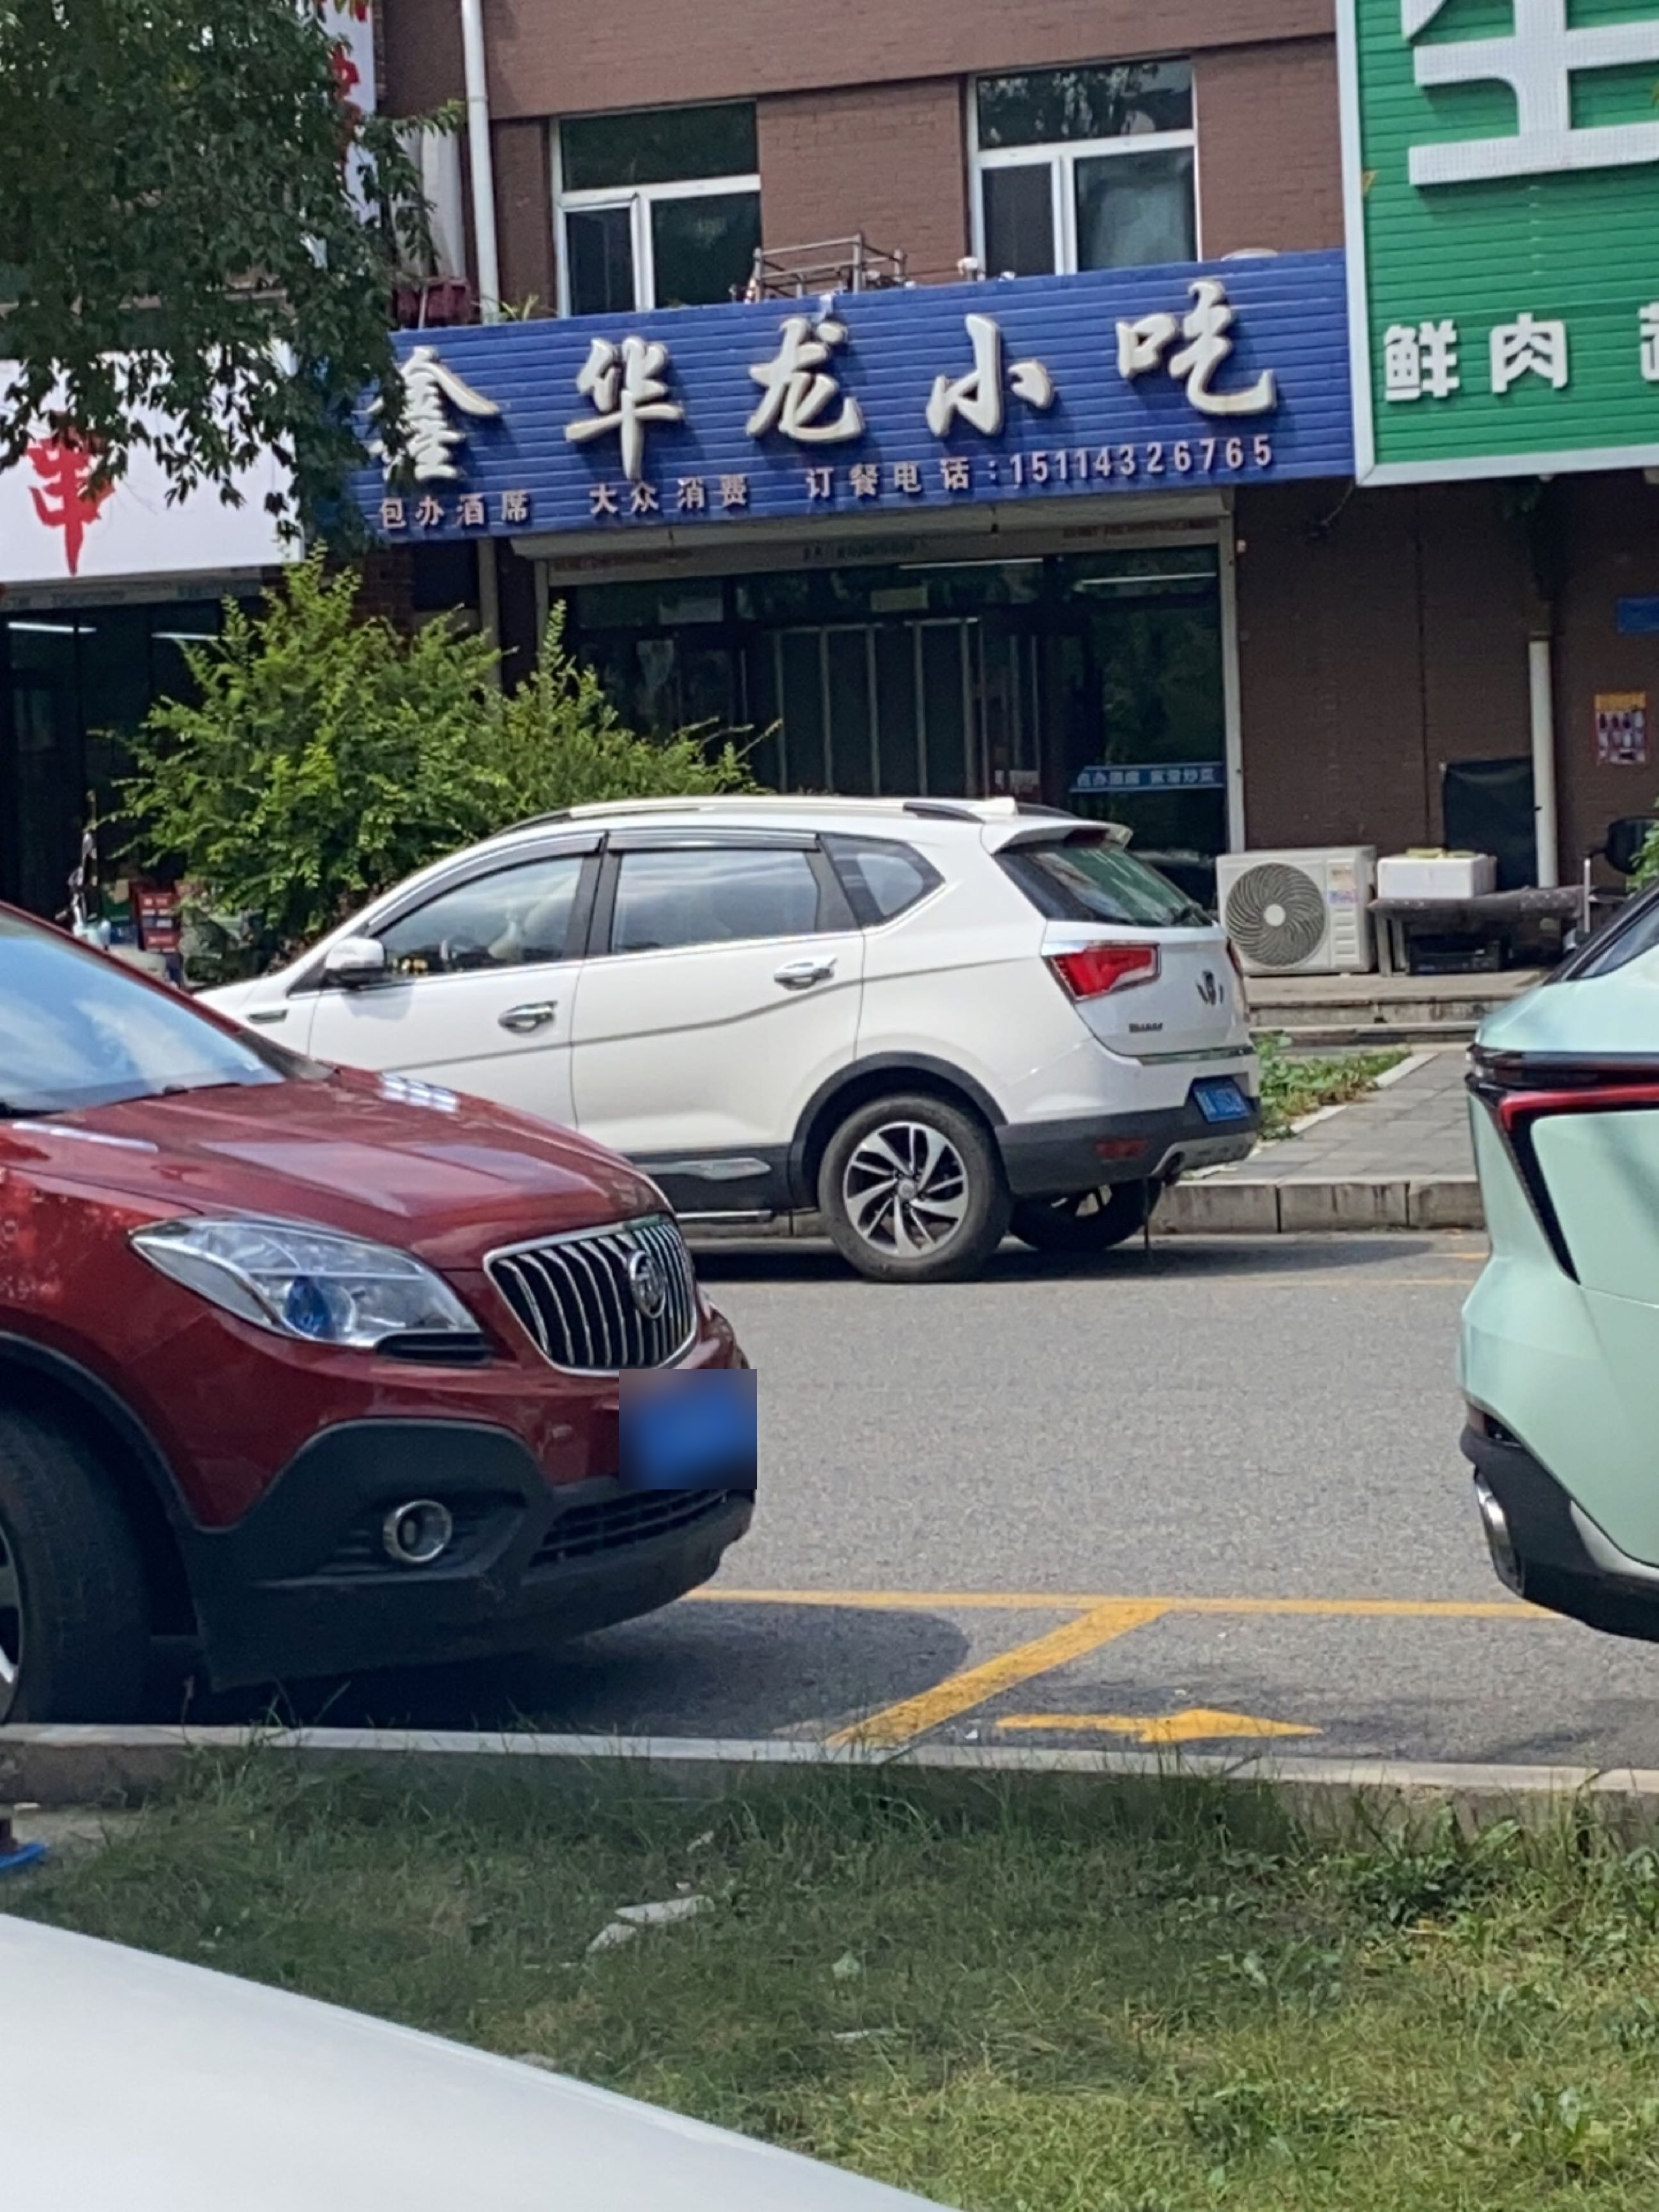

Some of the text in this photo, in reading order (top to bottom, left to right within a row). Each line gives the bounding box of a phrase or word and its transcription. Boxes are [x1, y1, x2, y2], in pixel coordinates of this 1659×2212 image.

[366, 279, 1277, 480] 鑫华龙小吃
[1384, 313, 1568, 401] 鲜肉
[380, 490, 529, 529] 包办酒席
[589, 474, 748, 515] 大众消费
